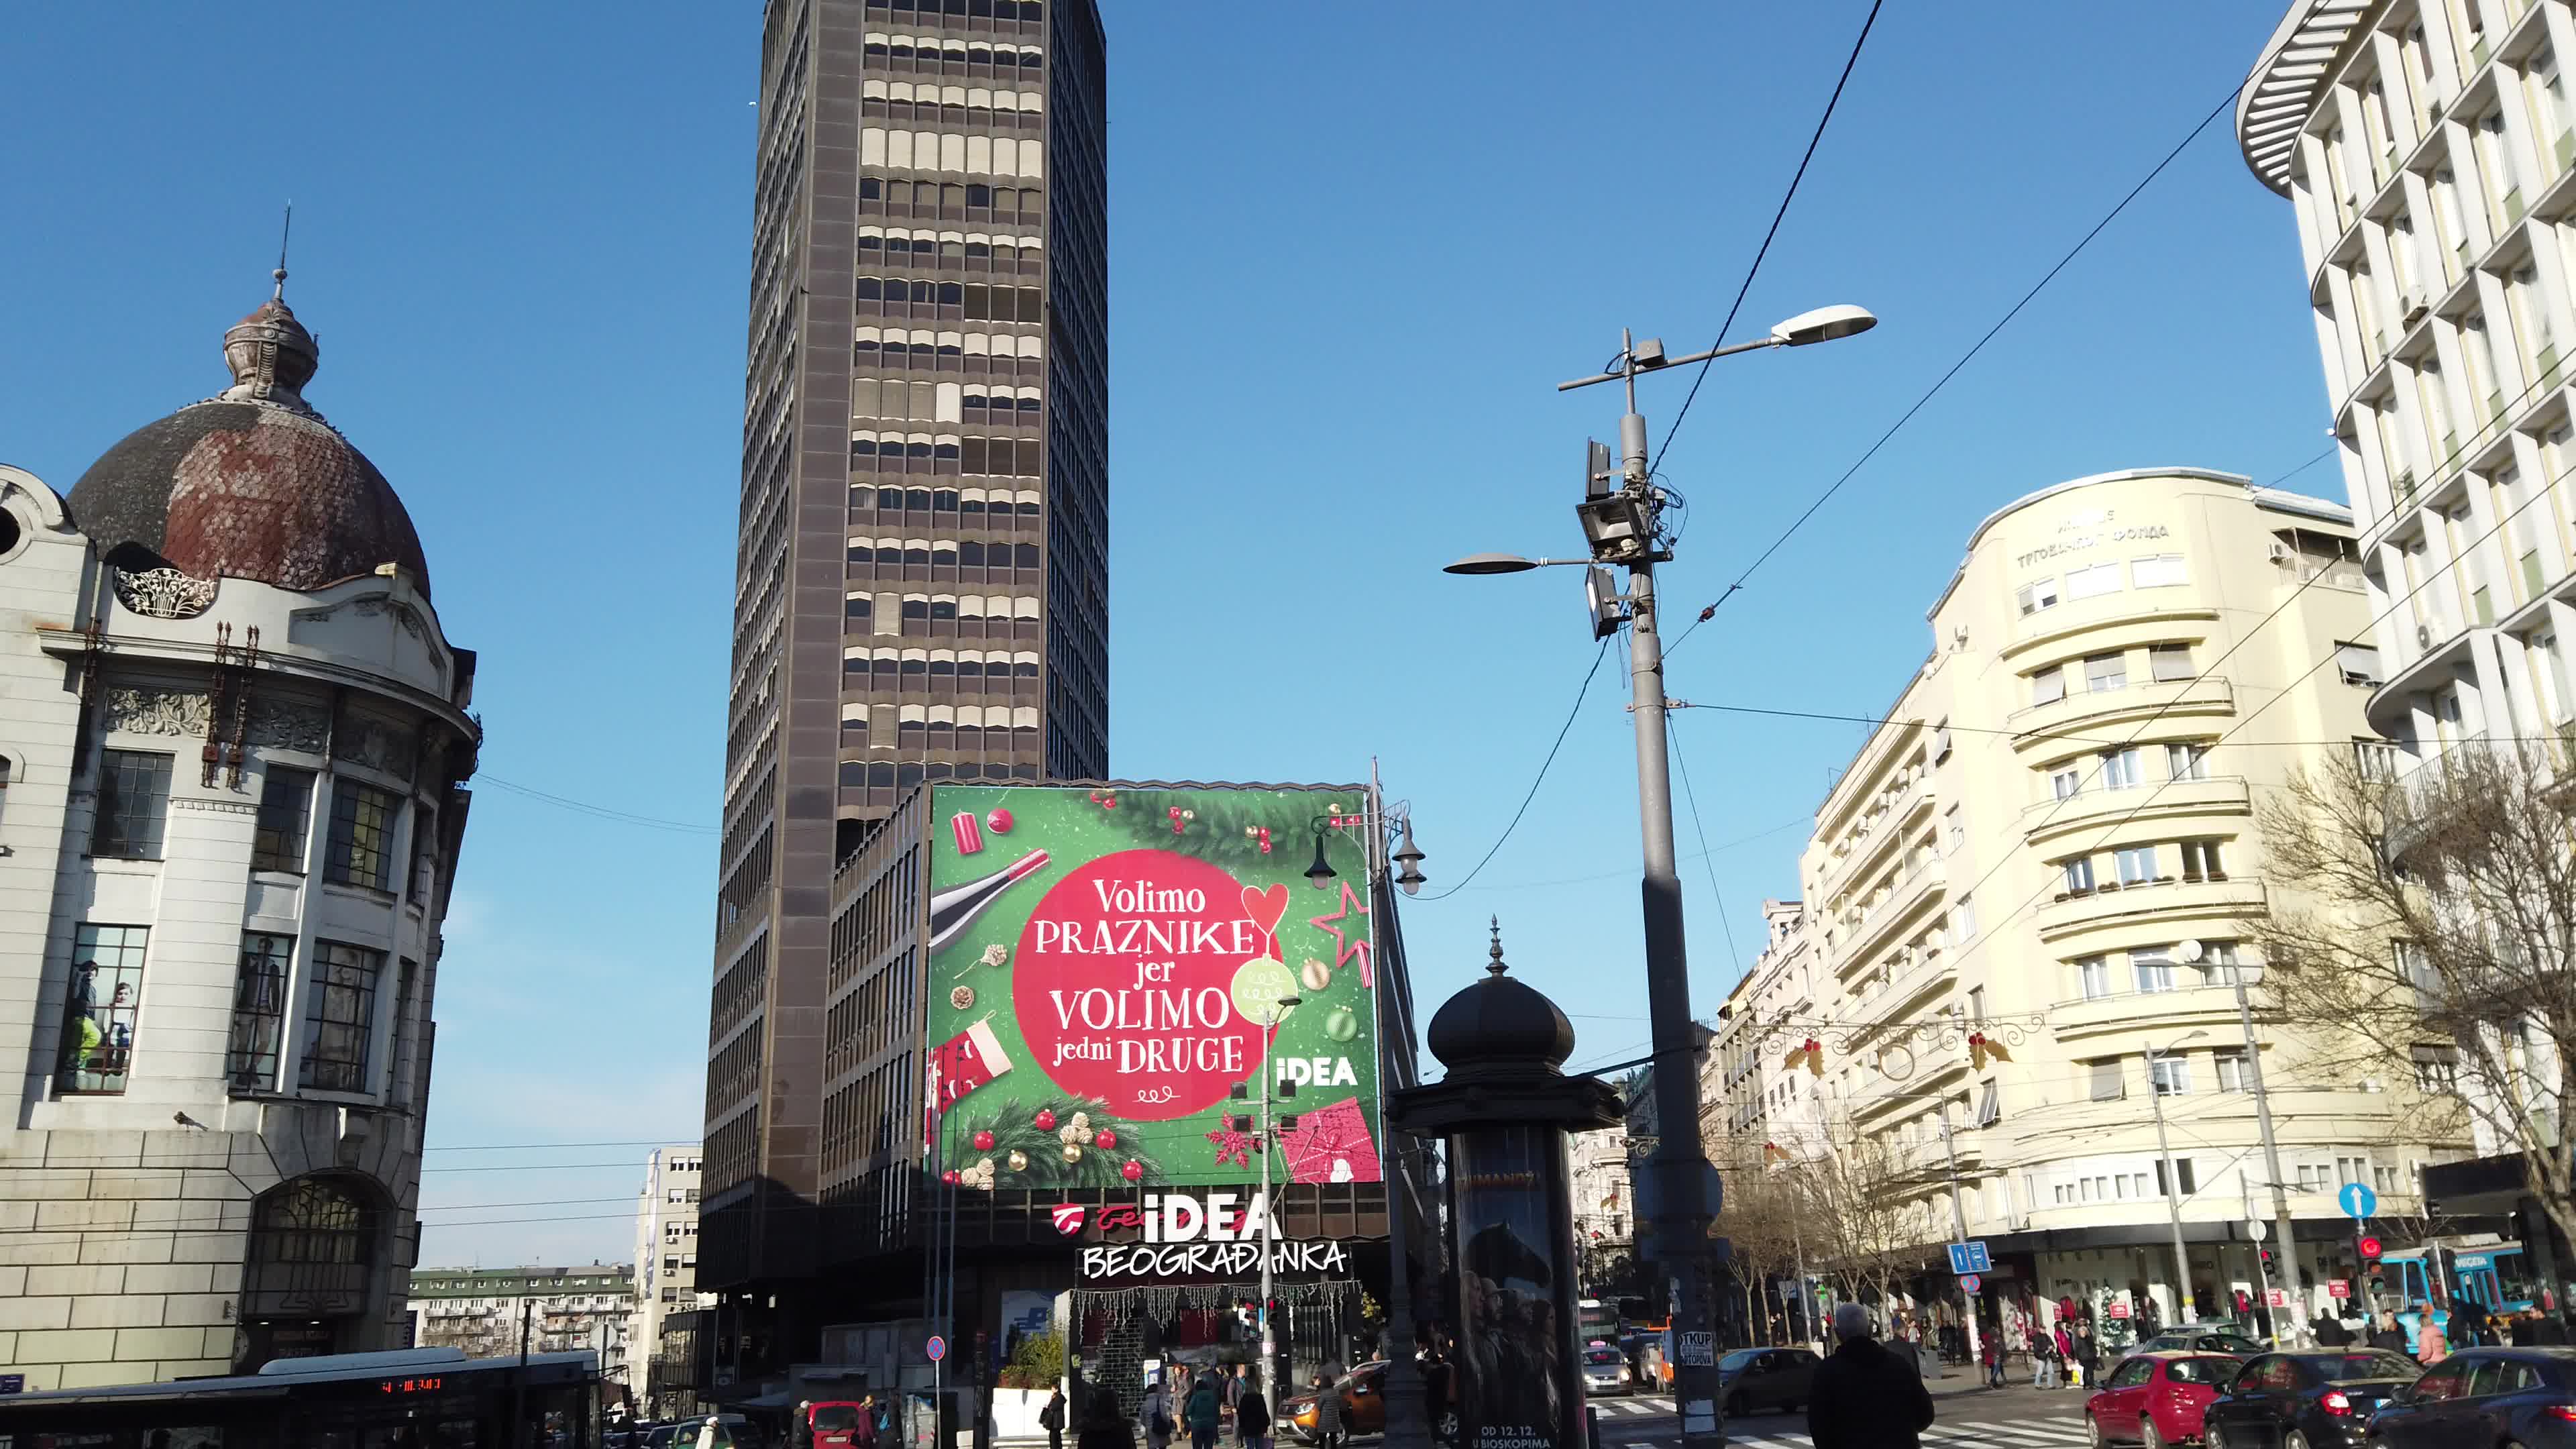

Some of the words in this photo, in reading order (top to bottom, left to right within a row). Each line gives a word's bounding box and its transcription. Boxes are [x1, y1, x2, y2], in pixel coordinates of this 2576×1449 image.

[1092, 879, 1205, 913] Volimo
[1034, 919, 1255, 955] PRAZNIKE
[1133, 955, 1175, 990] jer
[1049, 987, 1230, 1031] VOLIMO
[1053, 1036, 1112, 1067] jedni
[1116, 1035, 1244, 1074] DRUGE
[1083, 1240, 1347, 1279] BEOGRAĐANKA
[1472, 1439, 1479, 1449] U
[1481, 1438, 1551, 1449] BIOSKOPIMA
[1481, 1426, 1497, 1436] OD
